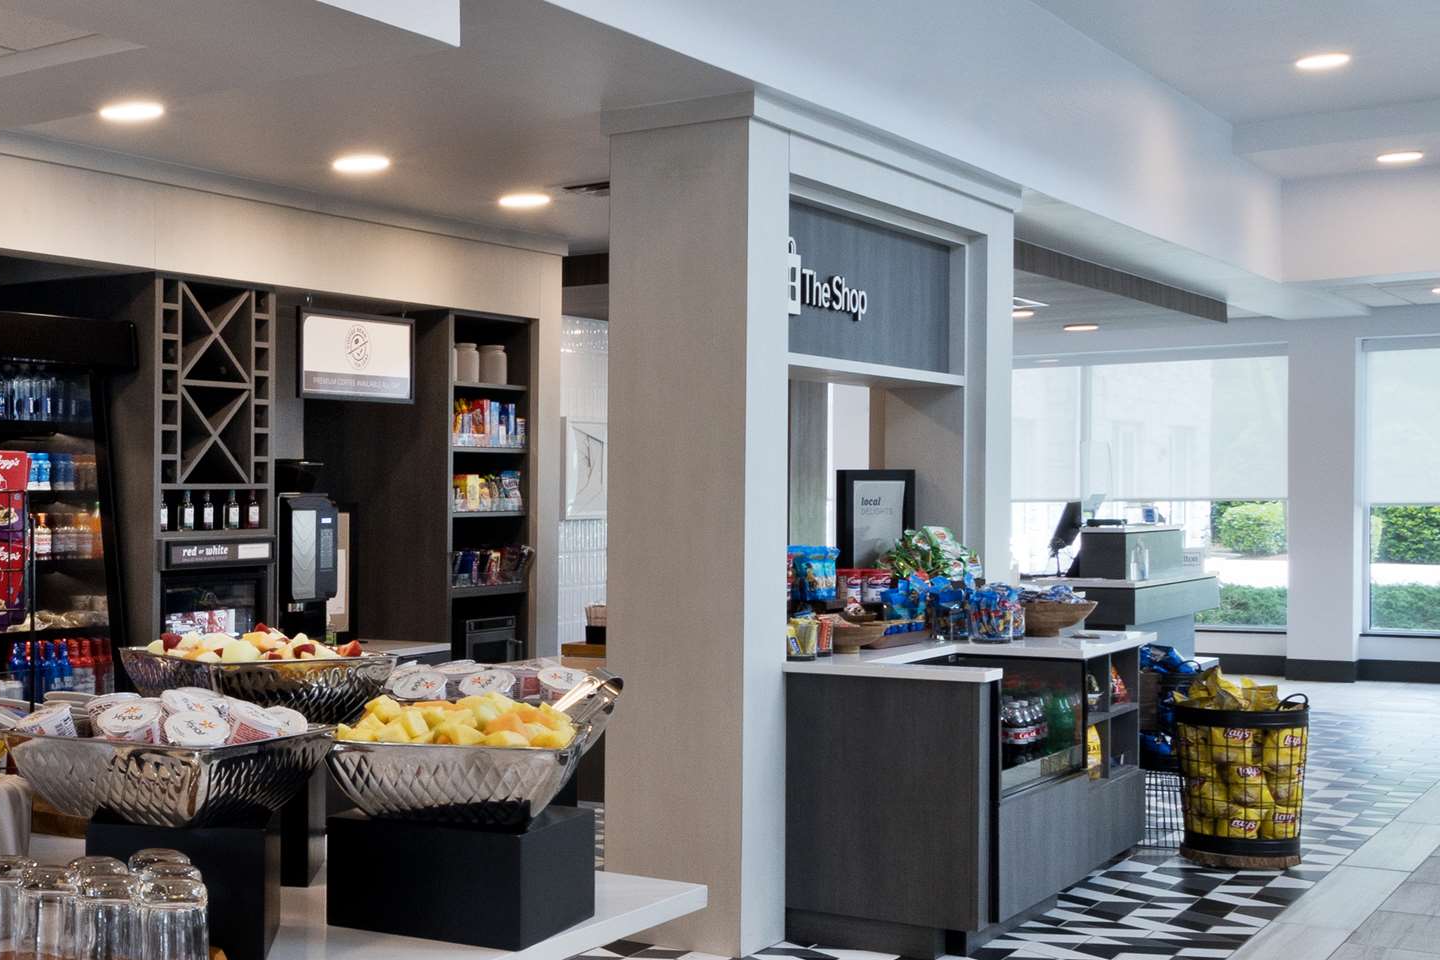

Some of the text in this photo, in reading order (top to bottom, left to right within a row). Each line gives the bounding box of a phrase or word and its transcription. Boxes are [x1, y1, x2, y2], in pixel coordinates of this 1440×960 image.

[802, 268, 868, 321] The Shop
[861, 497, 881, 506] local
[182, 546, 198, 557] red
[205, 544, 229, 556] white
